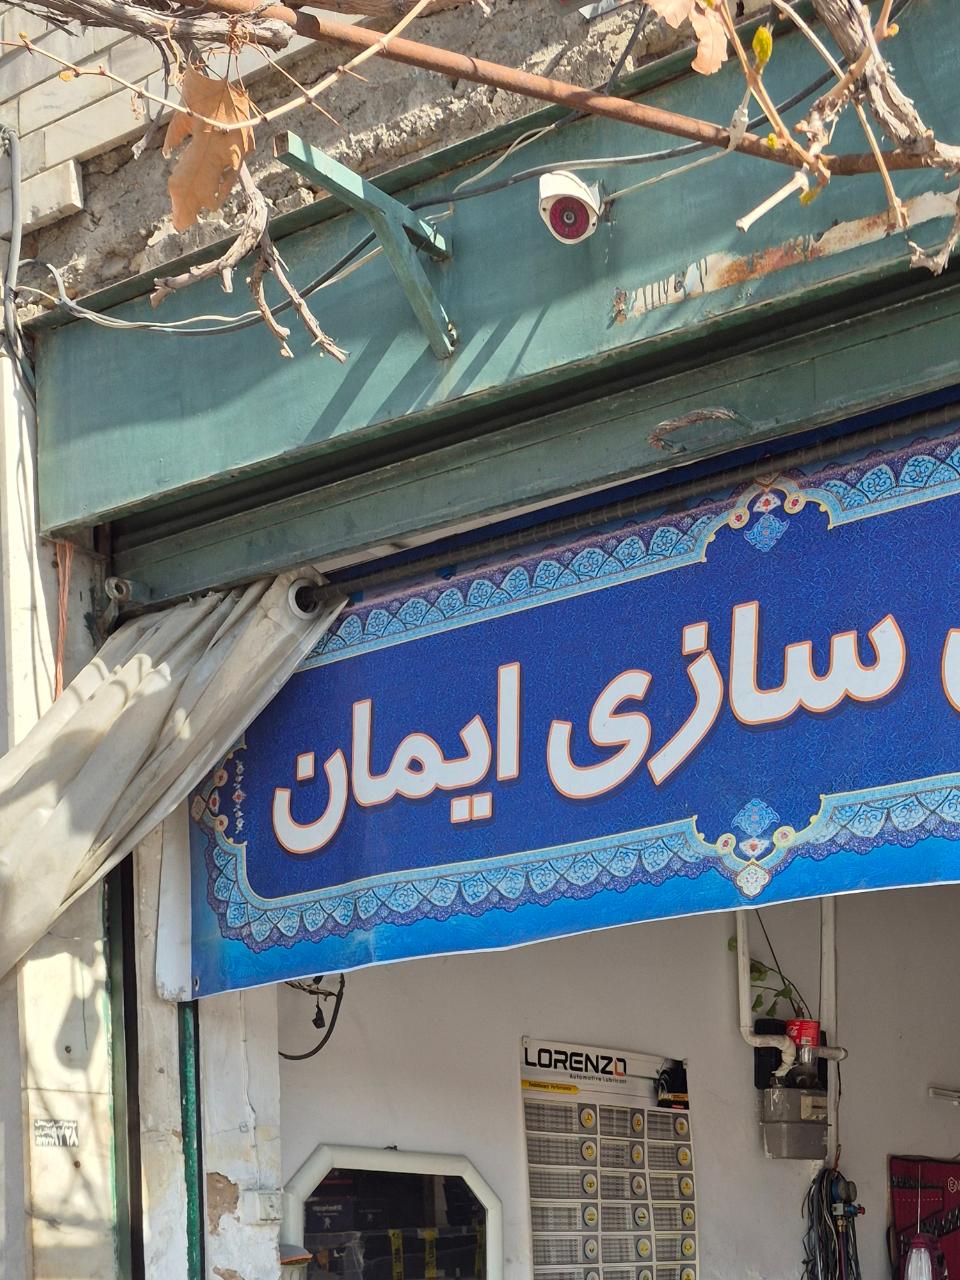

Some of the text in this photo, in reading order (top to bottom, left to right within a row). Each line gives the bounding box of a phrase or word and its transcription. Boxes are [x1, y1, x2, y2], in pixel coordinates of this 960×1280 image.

[271, 662, 522, 855] ایمان
[546, 599, 907, 800] سازی
[524, 1047, 627, 1077] LORENZO
